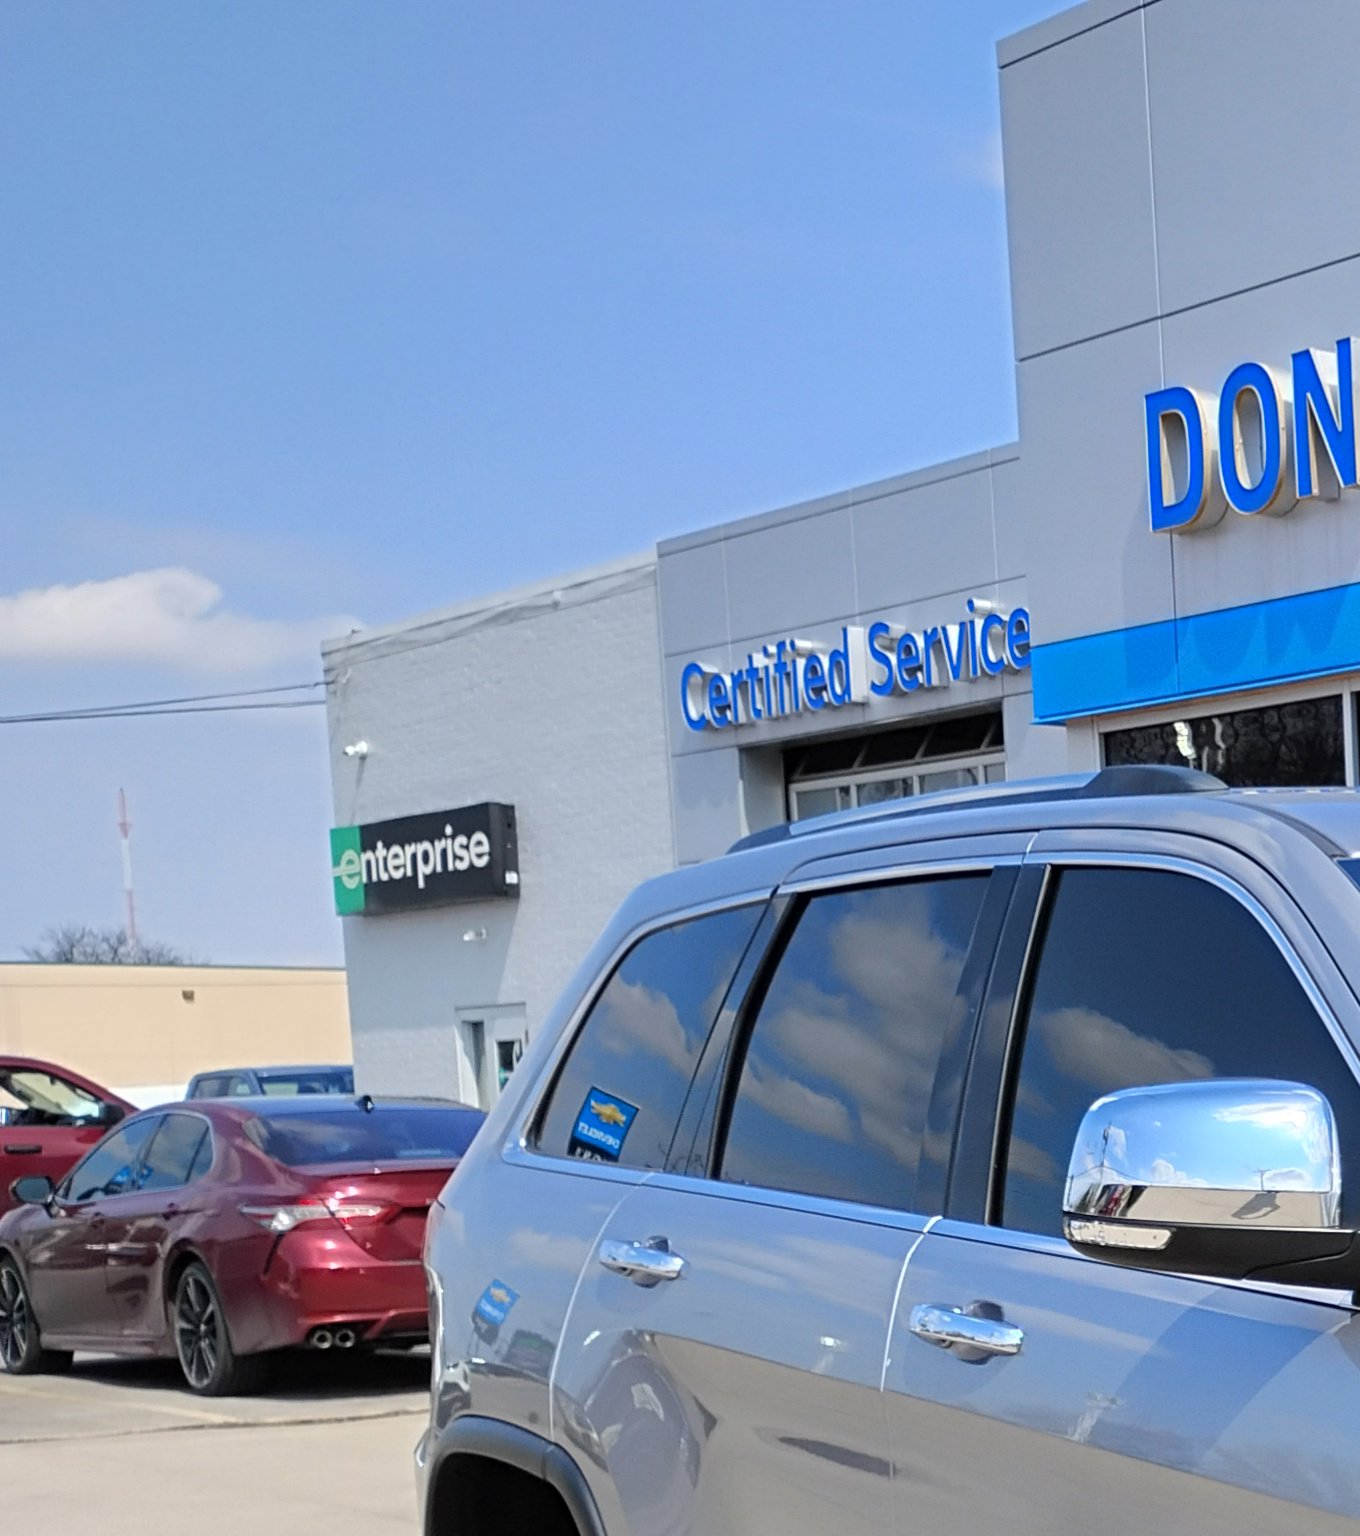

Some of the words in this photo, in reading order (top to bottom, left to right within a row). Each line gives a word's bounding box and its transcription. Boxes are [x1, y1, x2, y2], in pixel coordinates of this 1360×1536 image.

[680, 625, 856, 732] Certified
[868, 597, 1032, 698] Service
[333, 823, 491, 890] enterprise
